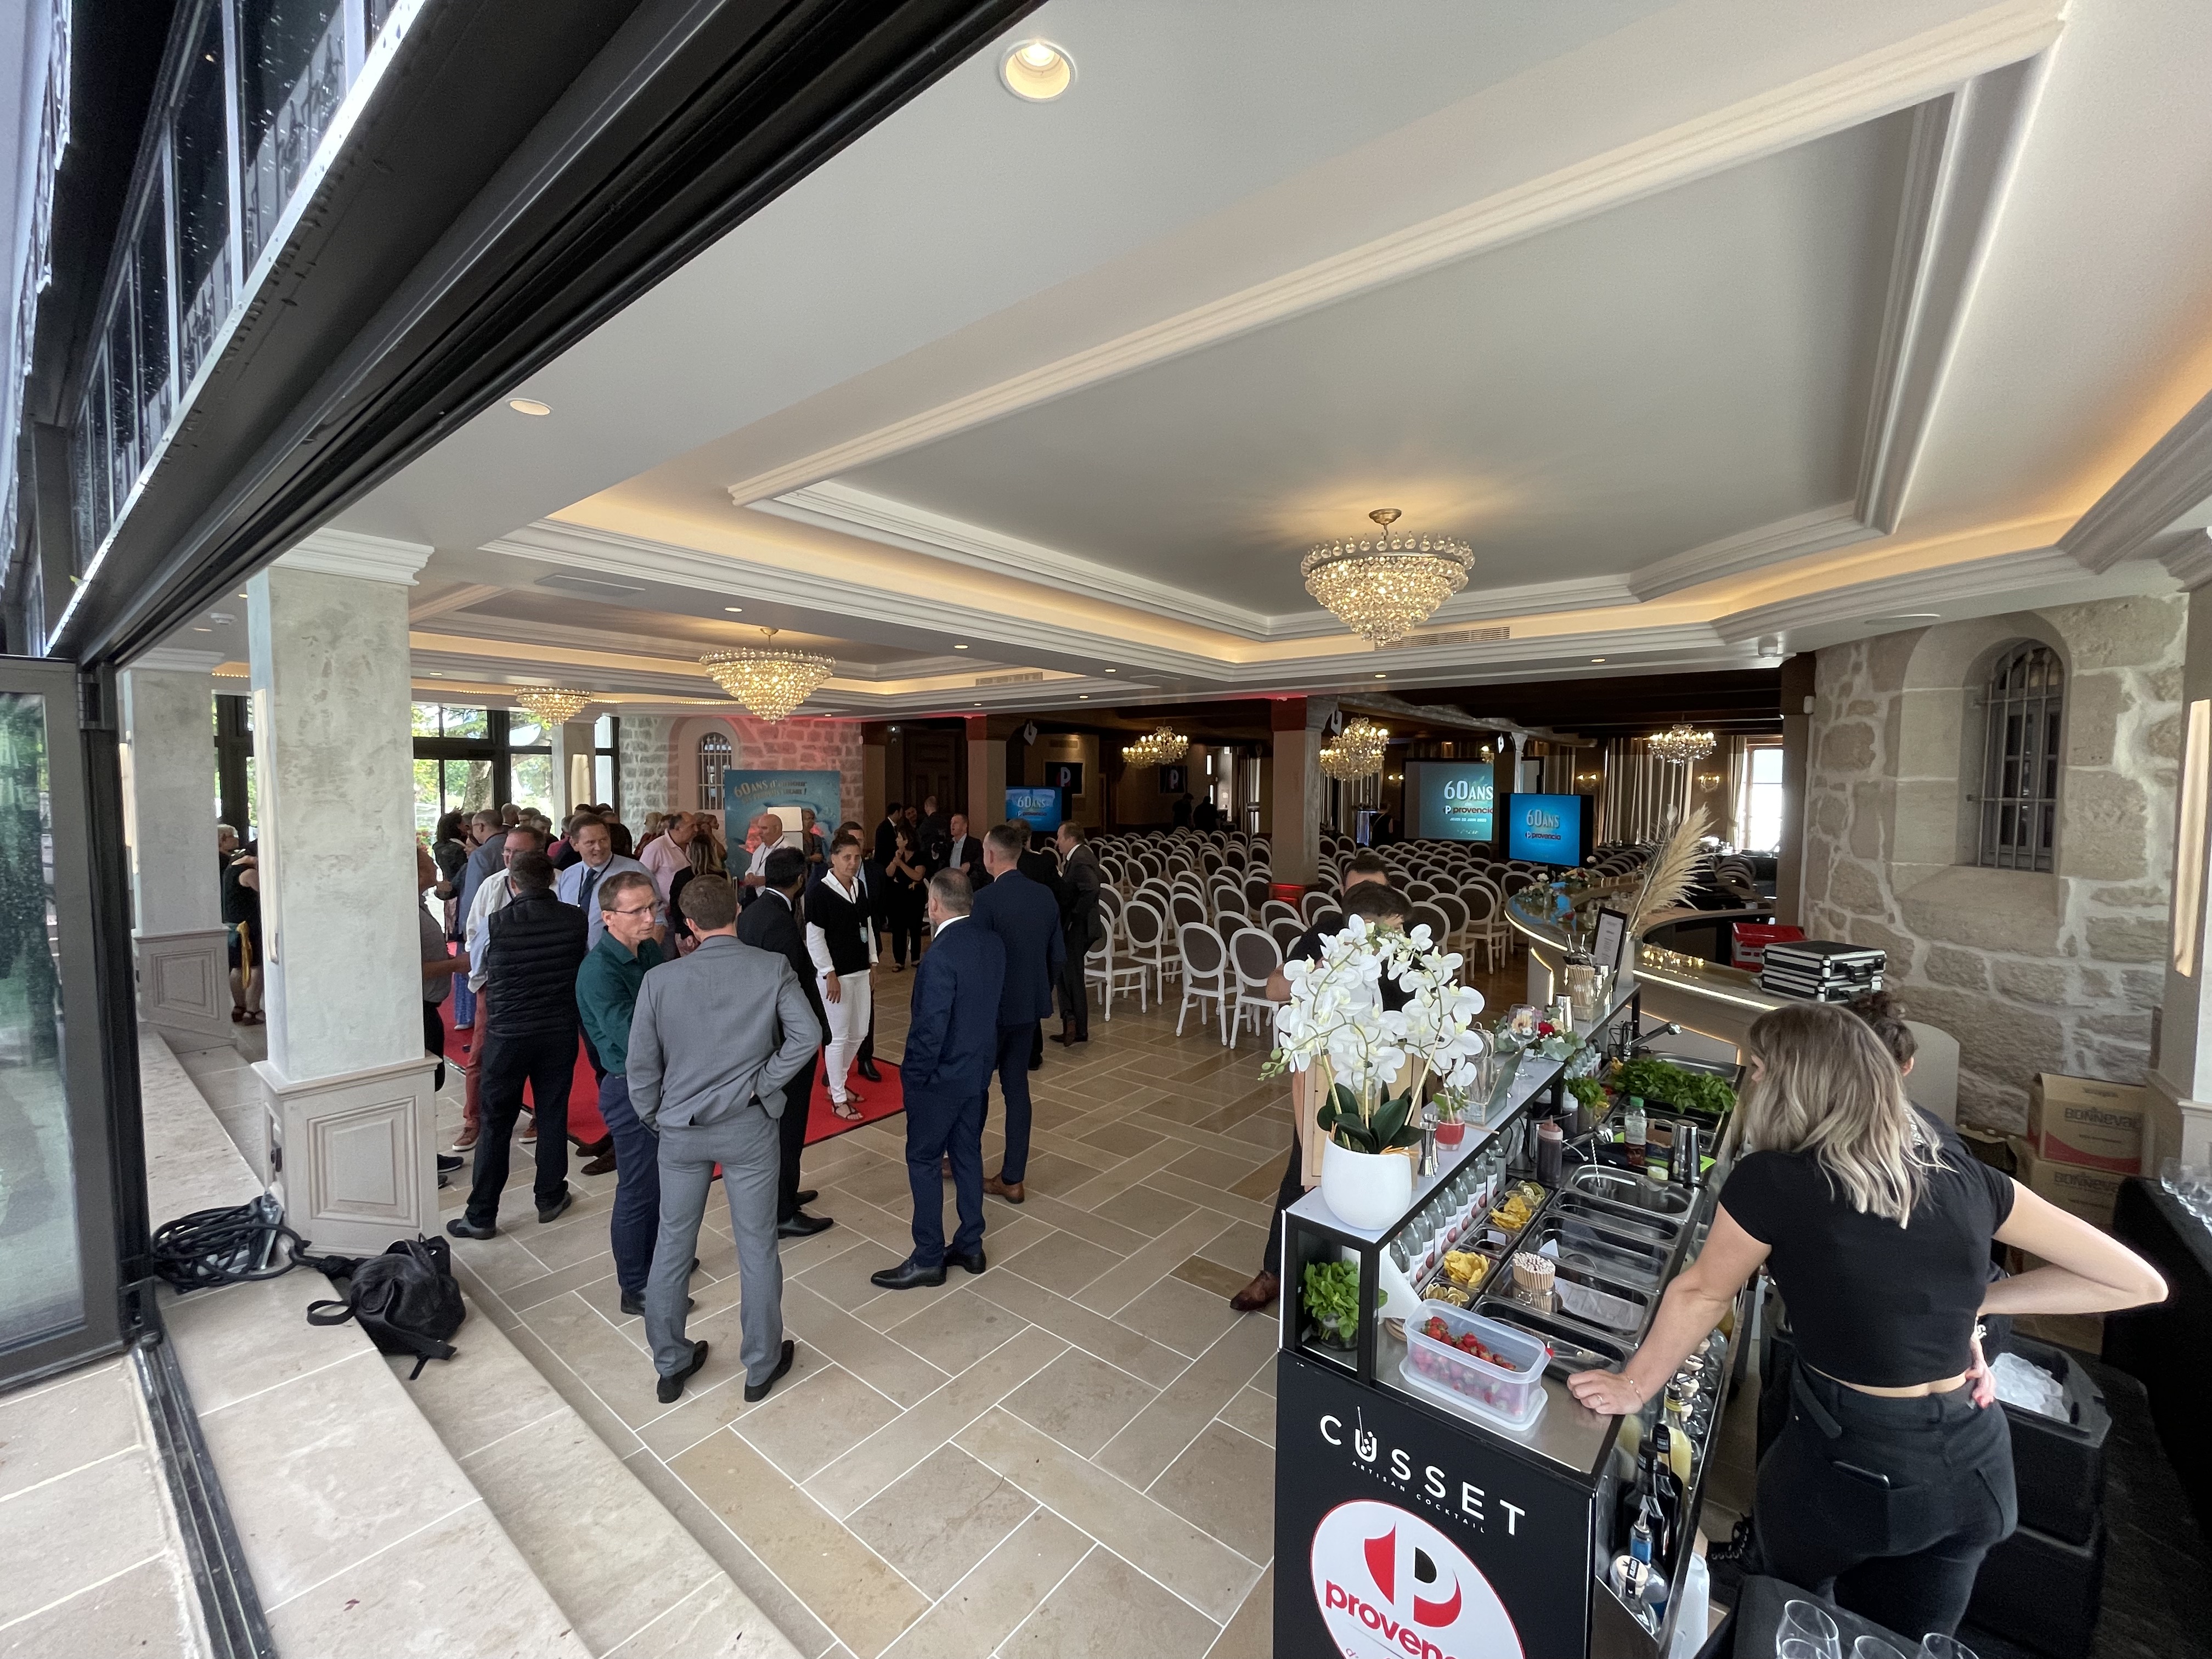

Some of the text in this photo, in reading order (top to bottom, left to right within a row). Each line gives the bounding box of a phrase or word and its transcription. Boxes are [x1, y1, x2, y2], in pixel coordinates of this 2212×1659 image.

[1443, 780, 1493, 800] 60ANS
[1526, 809, 1560, 828] 60ANS
[1320, 1414, 1526, 1536] CUSSET
[1352, 1460, 1406, 1492] ARTISAN
[1416, 1493, 1485, 1534] COCKTAIL
[1325, 1579, 1458, 1659] proven
